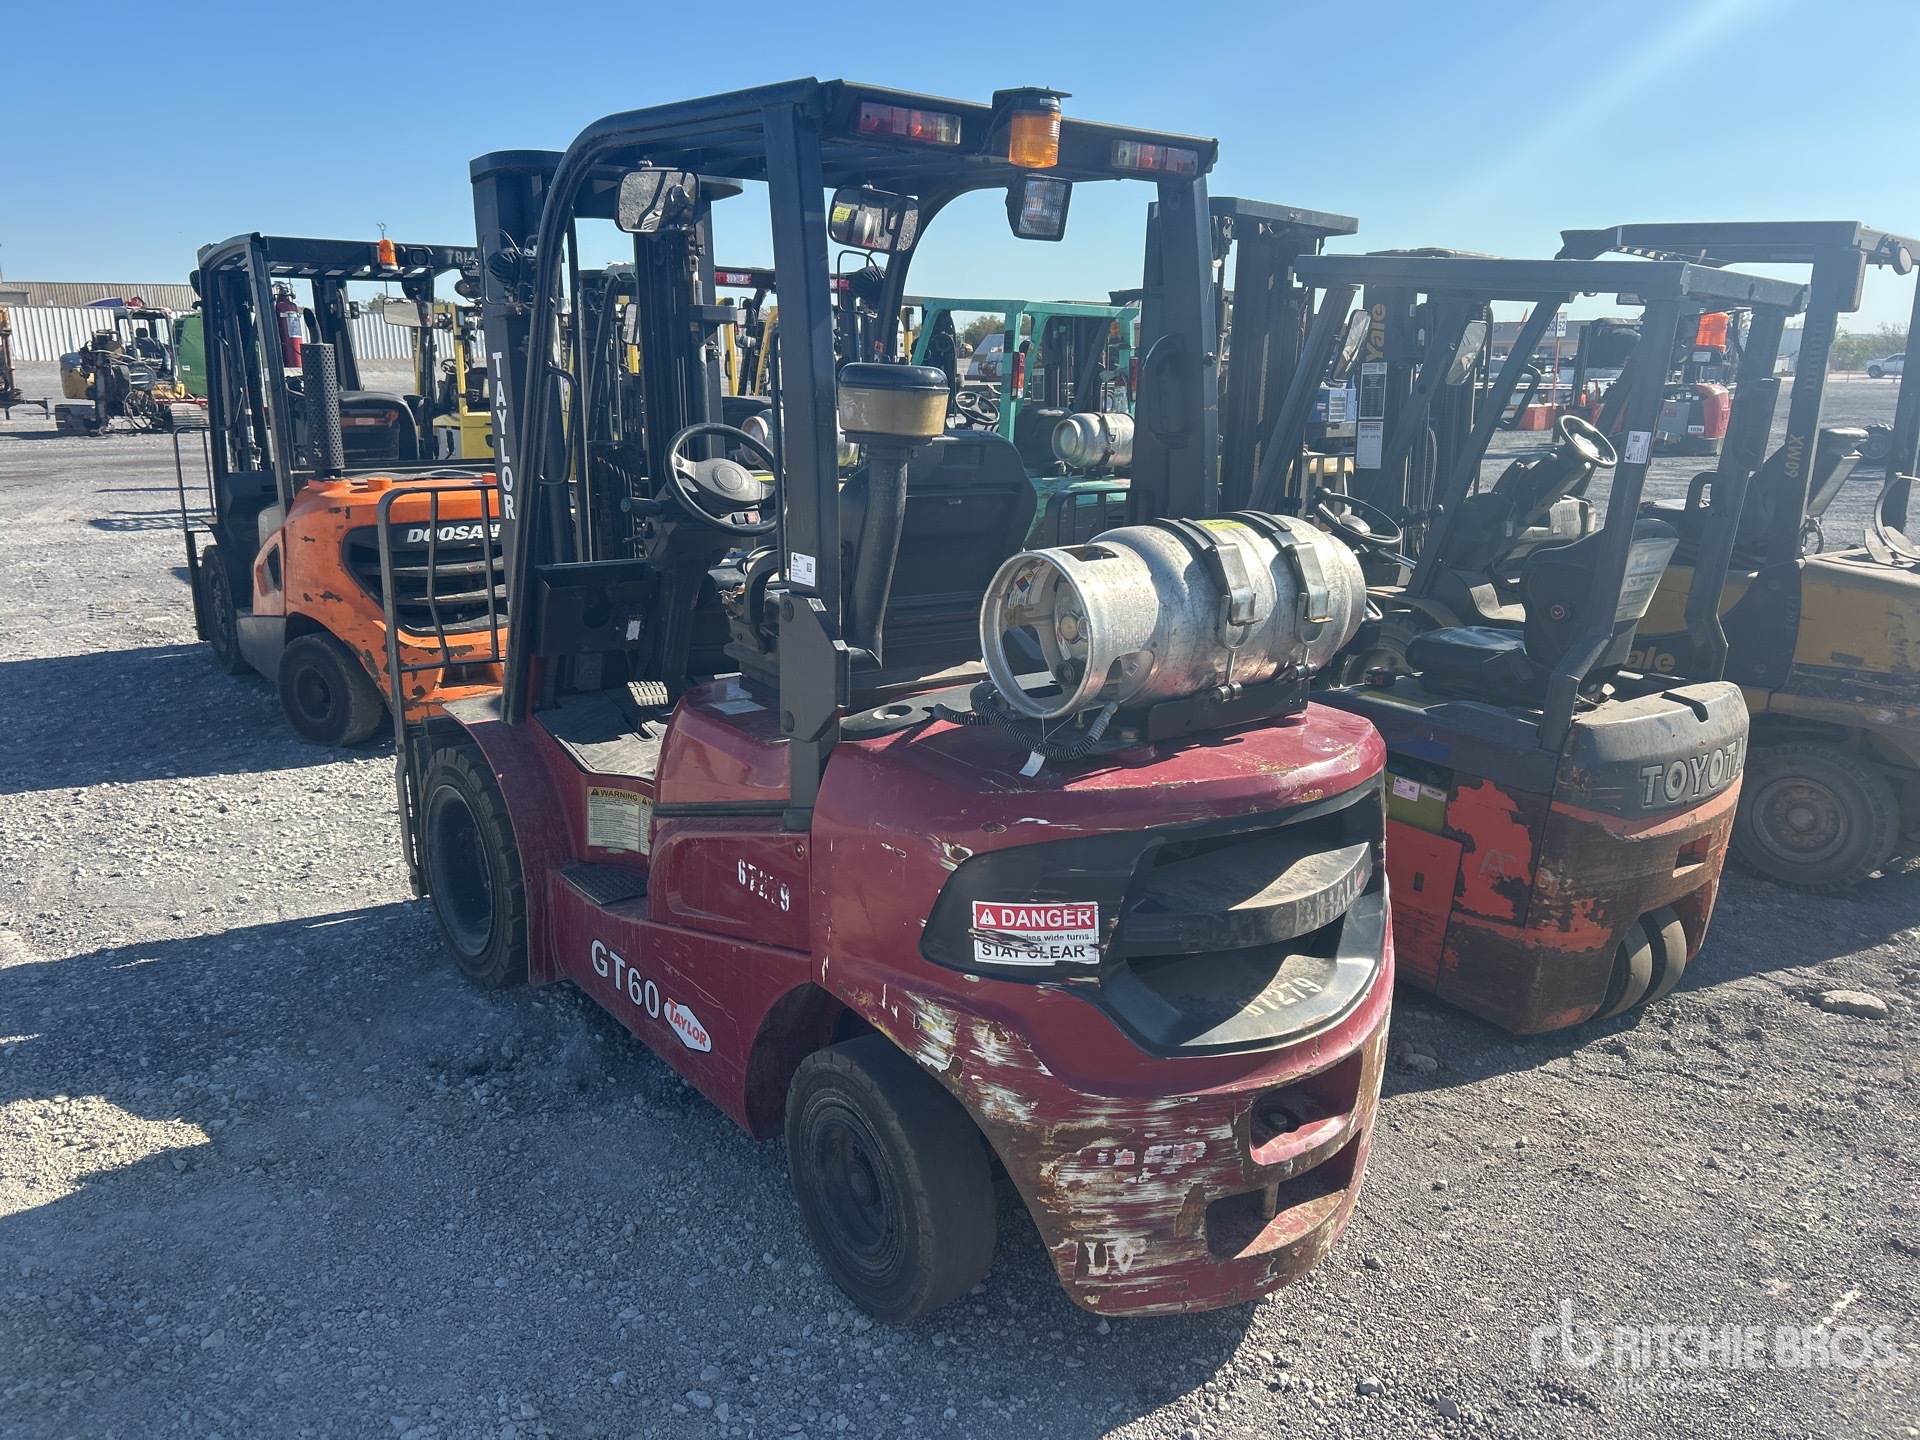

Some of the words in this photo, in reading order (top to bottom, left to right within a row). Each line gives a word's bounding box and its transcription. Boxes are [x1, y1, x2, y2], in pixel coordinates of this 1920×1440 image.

[1365, 303, 1386, 362] Yale
[1558, 321, 1566, 332] 52
[492, 351, 516, 520] TAYLOR
[1784, 434, 1805, 478] 60MX
[1625, 646, 1676, 673] ale
[1641, 736, 1743, 807] TOYOTA
[600, 789, 638, 802] WARNING
[1001, 908, 1092, 928] DANGER
[1044, 933, 1064, 941] wide
[1067, 932, 1092, 941] turns.
[591, 939, 660, 1019] GT60
[667, 997, 708, 1048] TAYLOR
